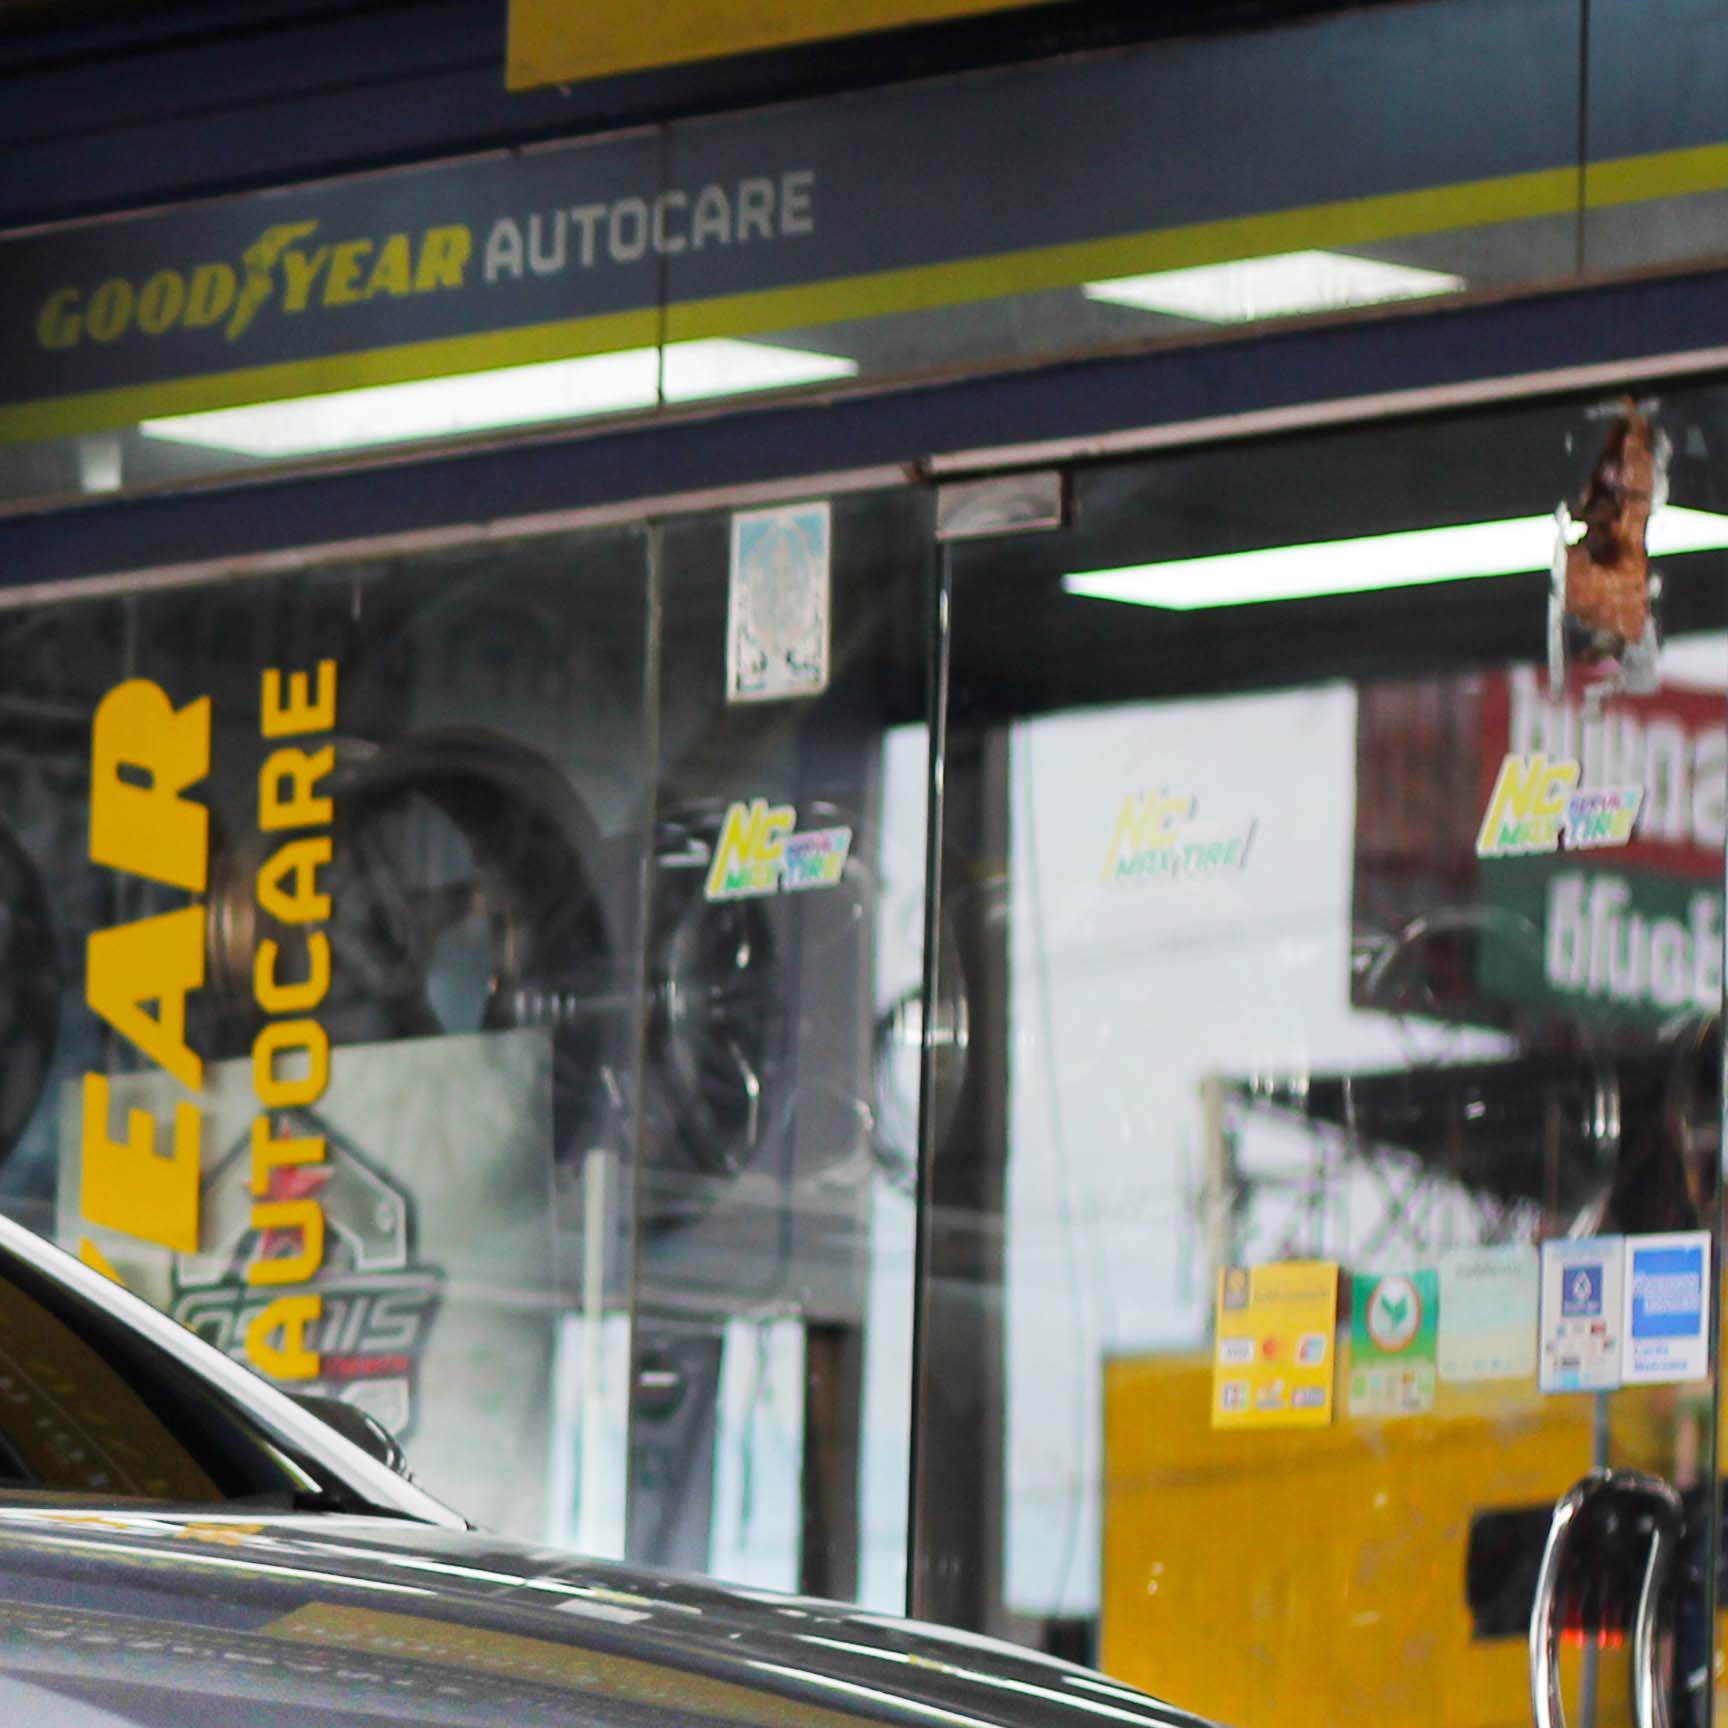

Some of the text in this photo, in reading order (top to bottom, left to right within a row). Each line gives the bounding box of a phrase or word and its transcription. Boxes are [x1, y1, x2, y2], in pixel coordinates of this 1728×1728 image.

[35, 170, 816, 350] GOODYEAR AUTOCARE
[711, 806, 792, 893] NC
[246, 658, 337, 1380] AUTOCARE
